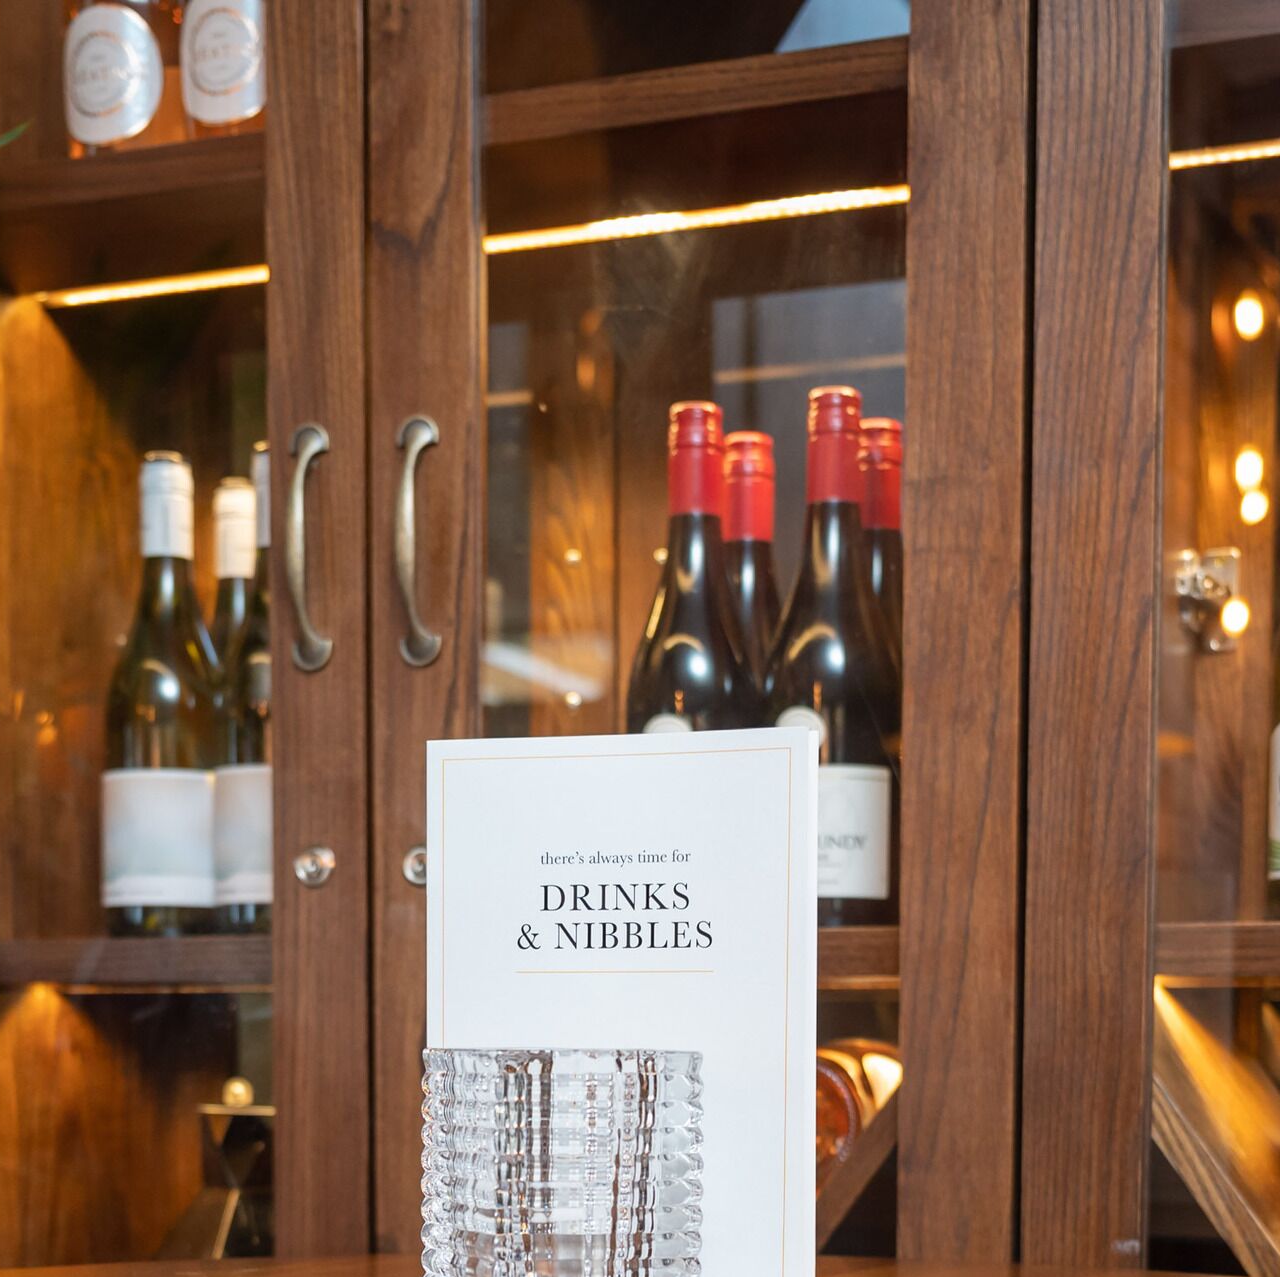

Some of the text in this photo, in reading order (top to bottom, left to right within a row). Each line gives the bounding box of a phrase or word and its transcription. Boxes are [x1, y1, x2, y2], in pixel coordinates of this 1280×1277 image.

[540, 849, 692, 868] there’s always time for
[539, 881, 691, 912] DRINKS
[516, 920, 714, 950] & NIBBLES
